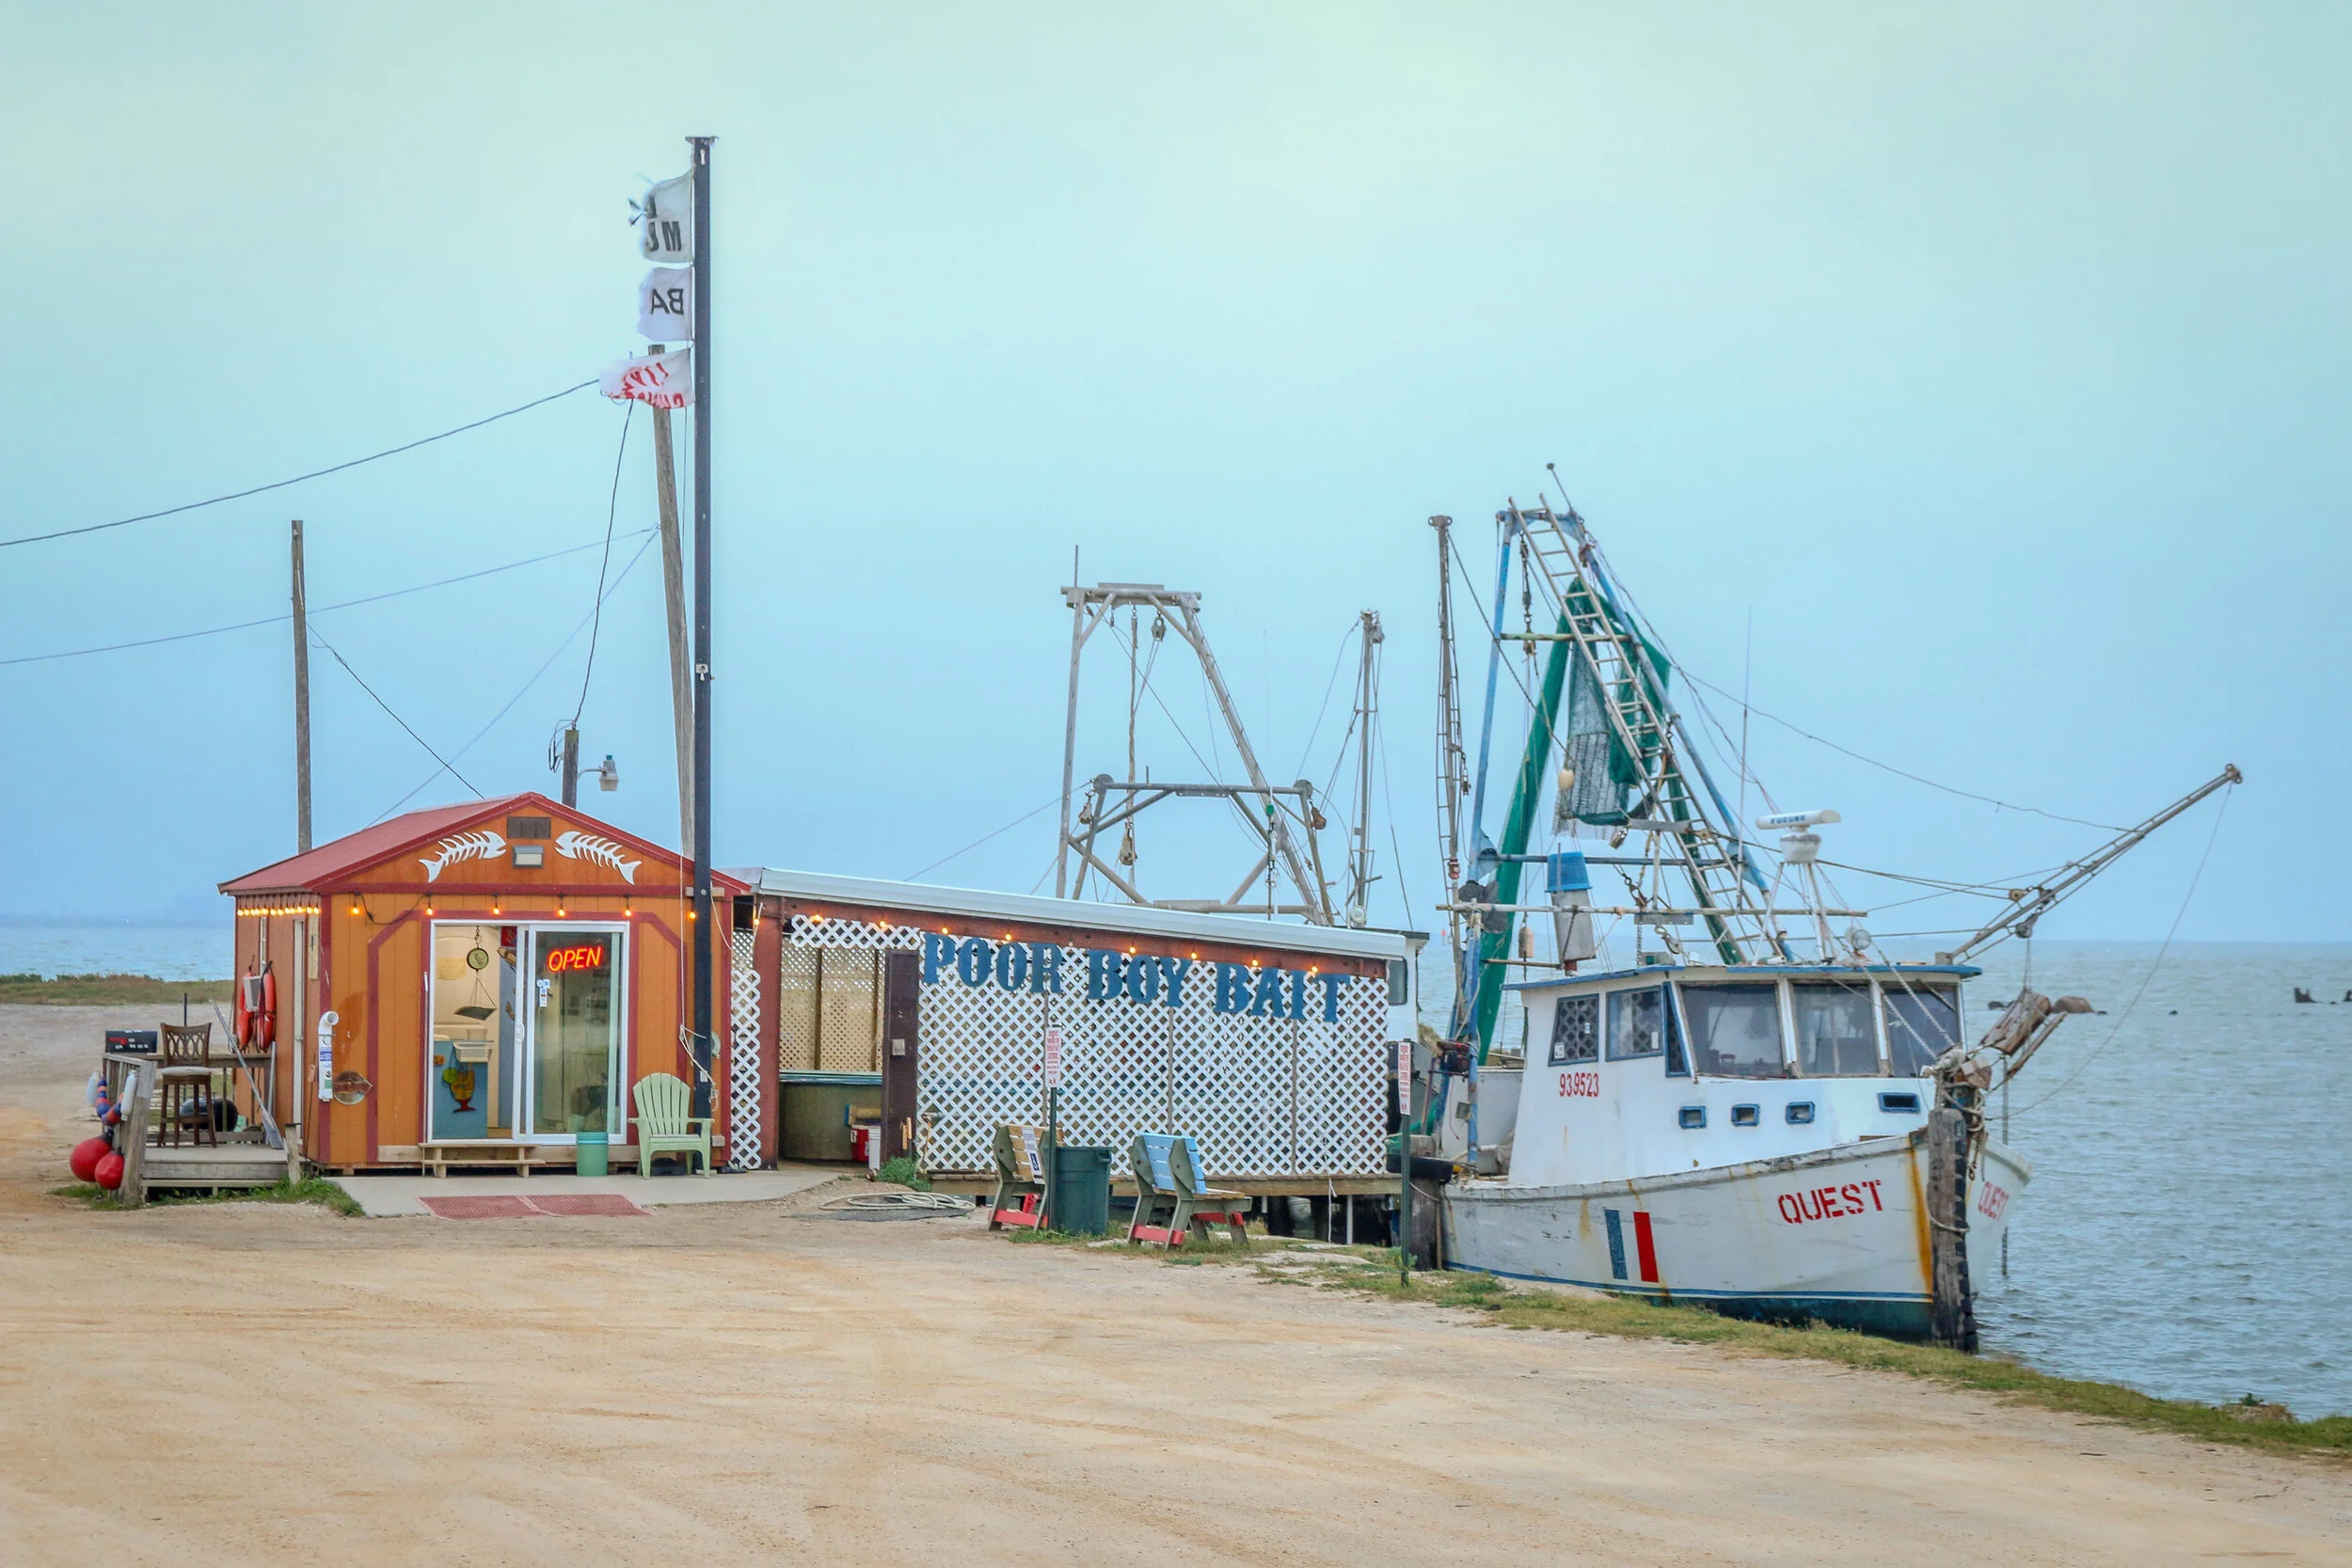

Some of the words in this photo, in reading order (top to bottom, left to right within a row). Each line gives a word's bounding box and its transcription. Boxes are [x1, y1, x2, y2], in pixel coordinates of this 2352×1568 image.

[548, 945, 602, 972] OPEN
[922, 932, 1063, 994] POOR
[1086, 948, 1192, 1007] BOY
[1214, 961, 1351, 1023] BAIT
[1559, 1072, 1599, 1097] 939523
[1777, 1180, 1883, 1225] QUEST
